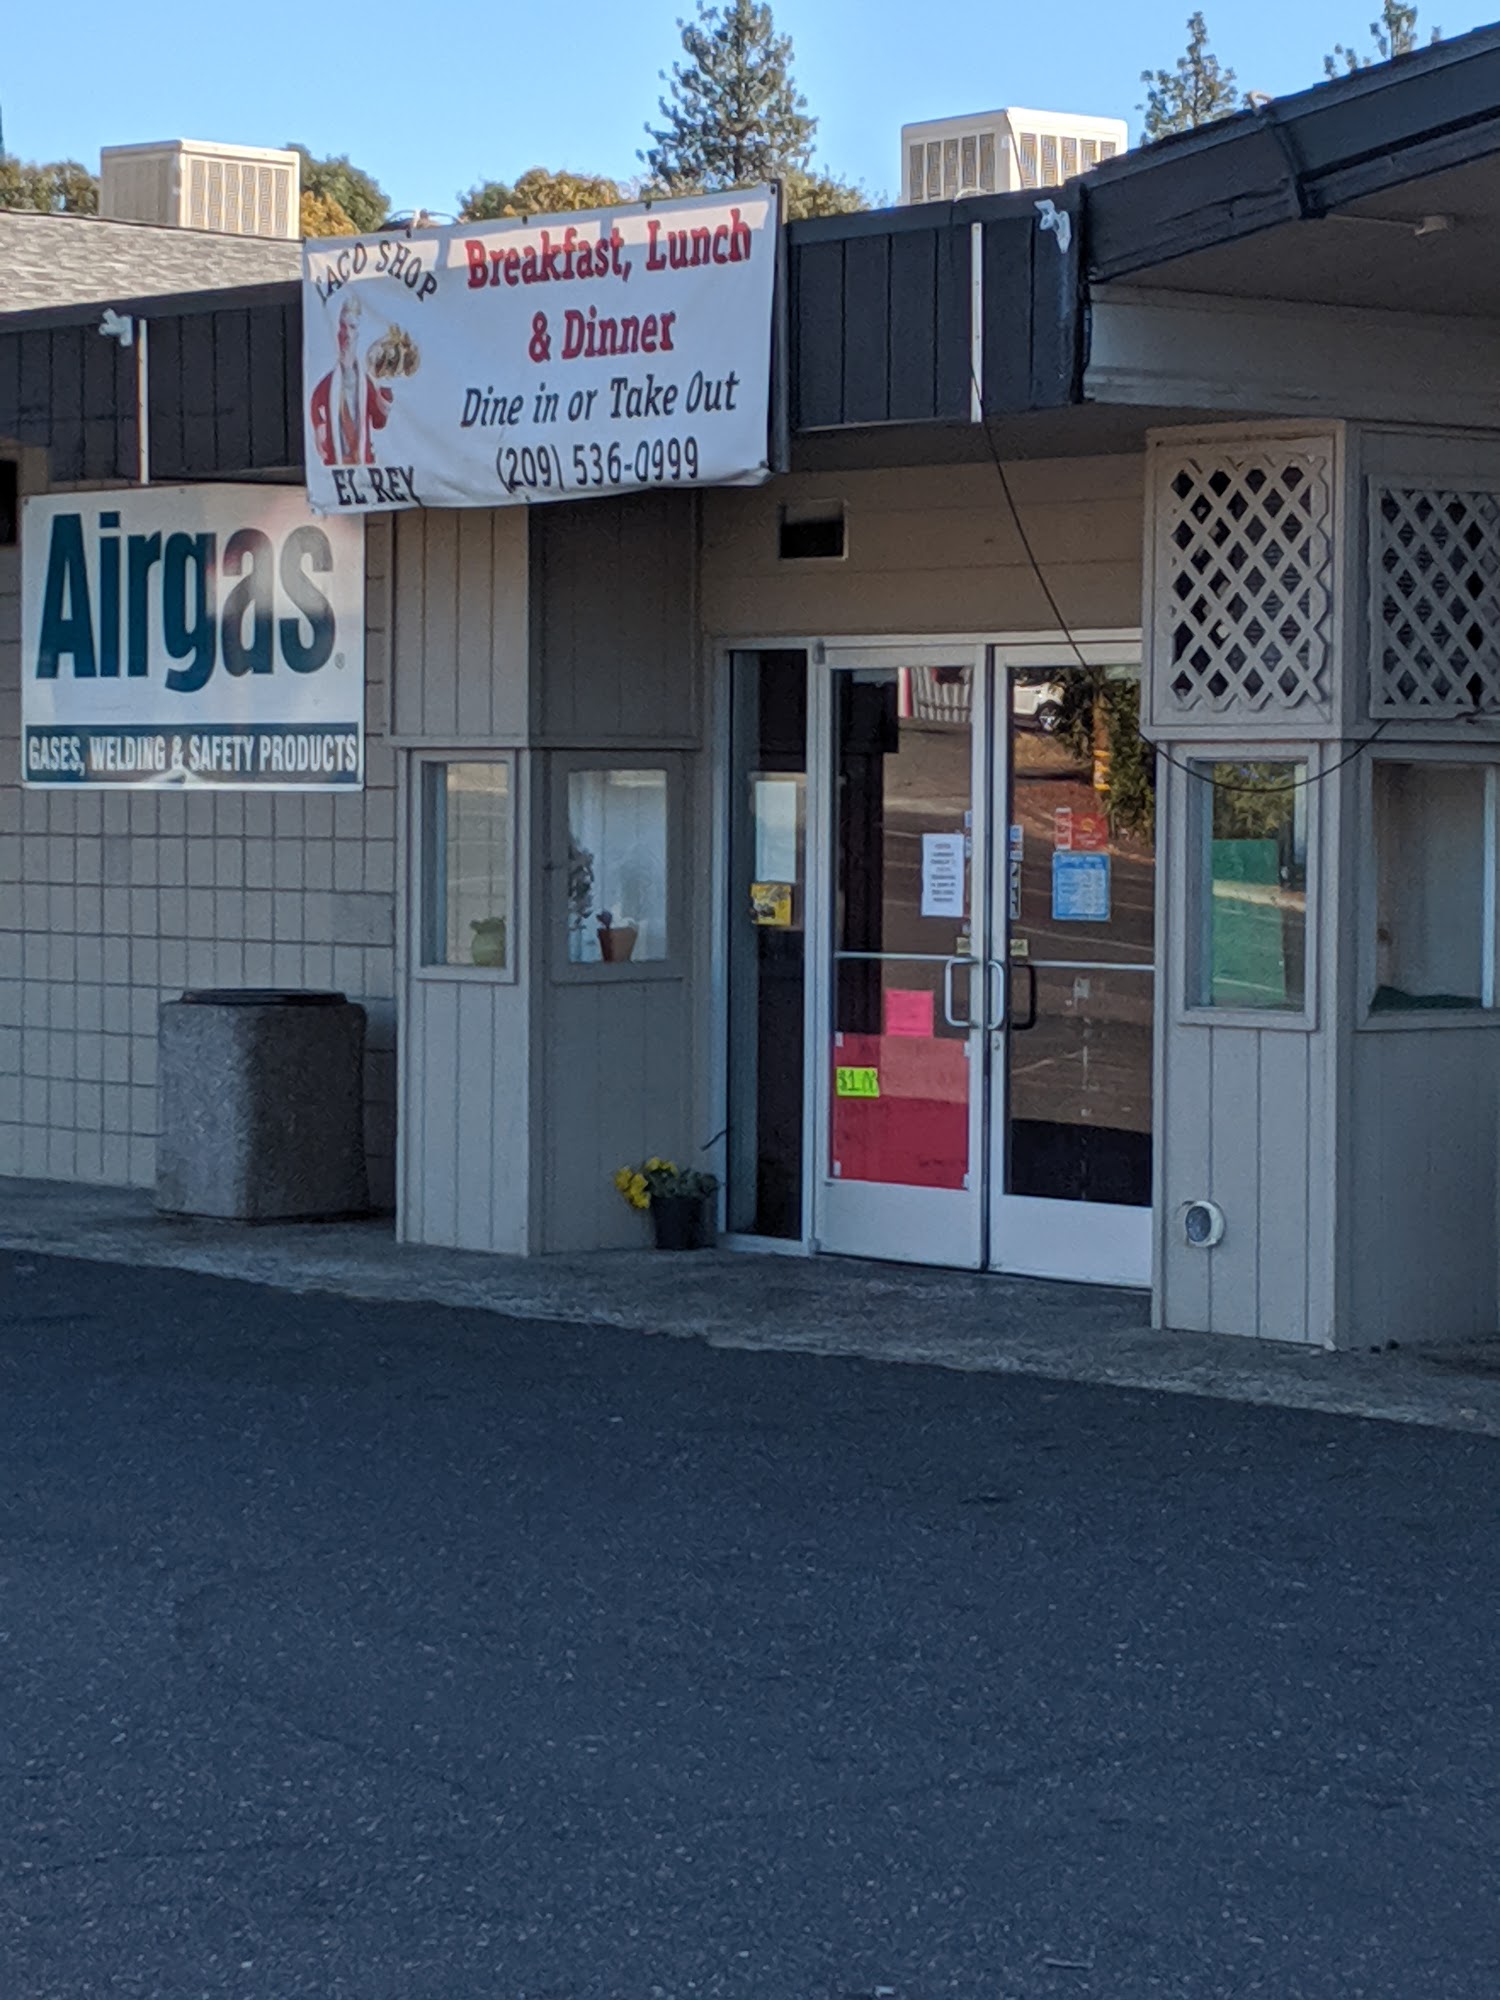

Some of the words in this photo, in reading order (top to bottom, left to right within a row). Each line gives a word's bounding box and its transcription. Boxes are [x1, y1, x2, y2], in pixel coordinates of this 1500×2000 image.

[375, 240, 437, 301] SHOP
[466, 225, 632, 289] Breakfast,
[645, 207, 751, 271] Lunch
[528, 311, 551, 363] &
[562, 305, 676, 360] Dinner
[460, 386, 523, 428] Dine
[533, 382, 560, 424] in
[568, 388, 597, 421] or
[610, 374, 677, 419] Take
[686, 371, 740, 414] Out
[331, 468, 367, 506] EL
[372, 466, 421, 506] REY
[496, 444, 563, 495] (209)
[573, 437, 698, 487] 536-0999
[36, 511, 336, 693] Airgas
[29, 735, 85, 776] GASES,
[90, 735, 165, 771] WELDING
[172, 735, 183, 770] &
[189, 735, 256, 771] SAFETY
[260, 734, 357, 772] PRODUCTS
